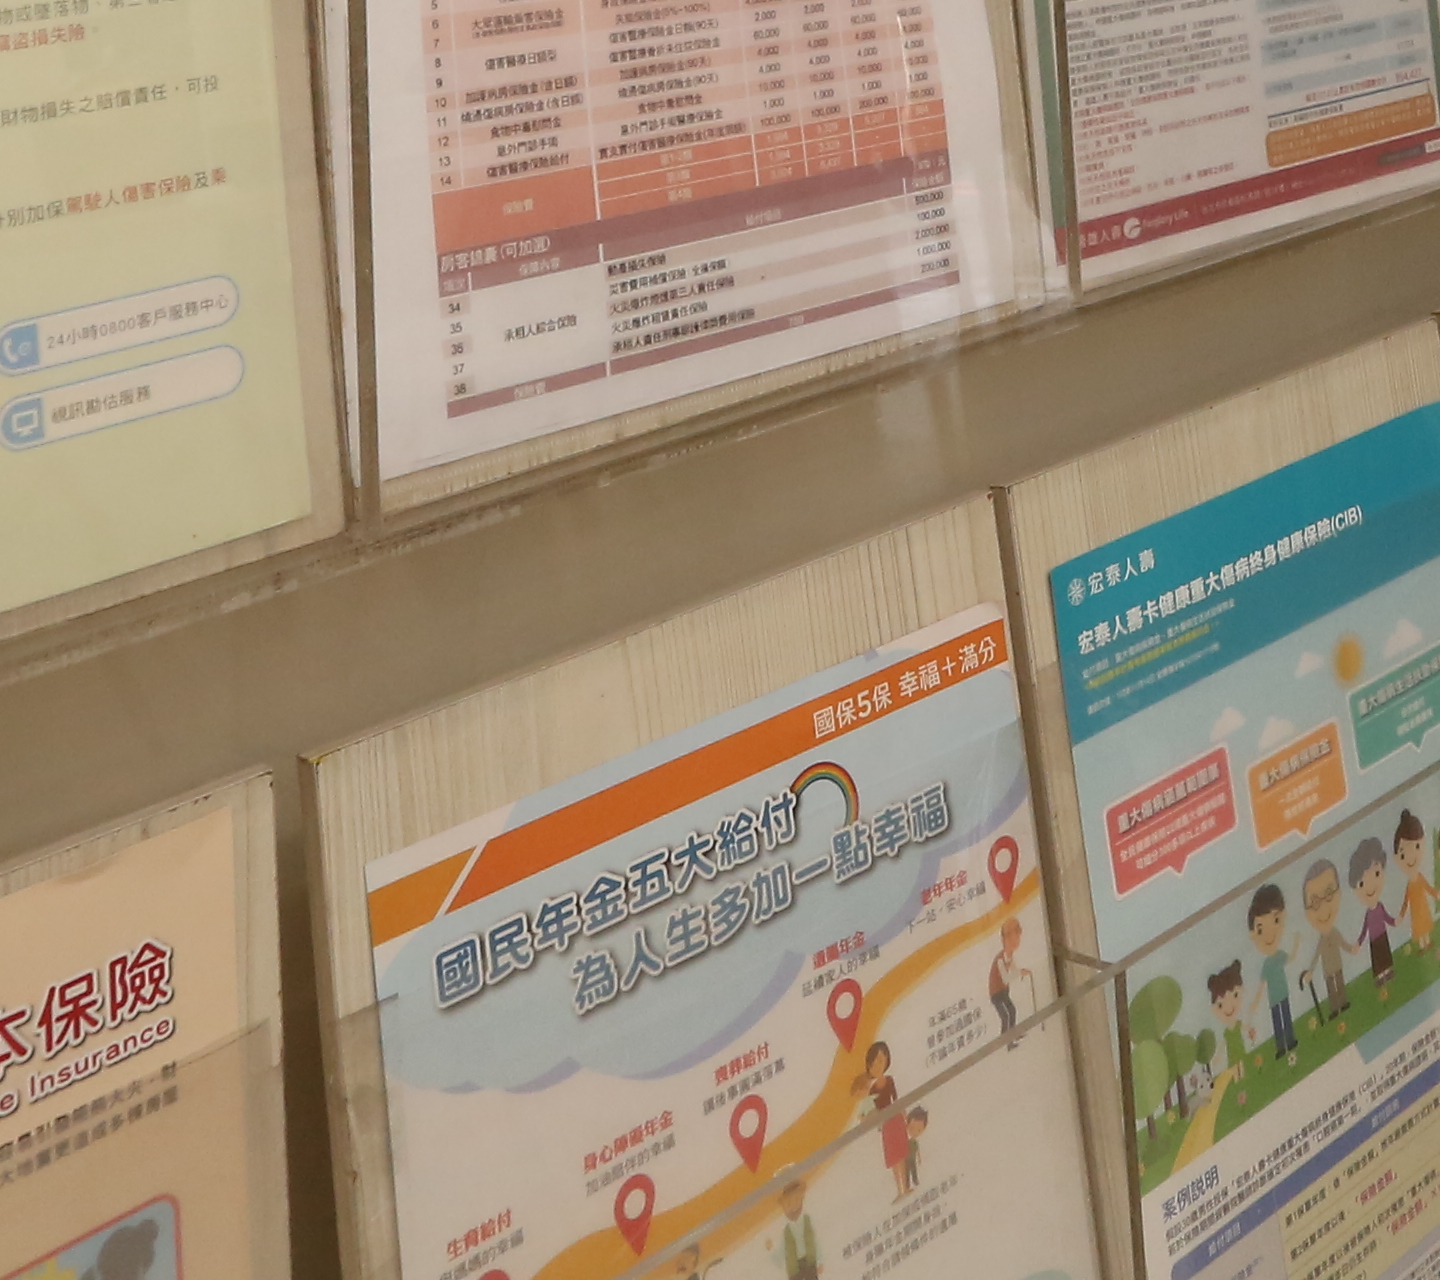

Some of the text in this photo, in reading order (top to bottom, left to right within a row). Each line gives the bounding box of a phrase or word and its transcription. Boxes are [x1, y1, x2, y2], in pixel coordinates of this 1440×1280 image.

[46, 292, 231, 350] 24小時0800客戶服務中心
[447, 301, 462, 315] 34
[451, 362, 466, 376] 37
[1077, 505, 1365, 657] 宏泰人壽卡健康重大傷病終身健康保險(CIB)
[1086, 547, 1157, 597] 宏泰人壽
[812, 636, 999, 741] 國保5保 幸福＋滿分
[435, 790, 798, 1010] 國民年金五大給付
[572, 782, 951, 1015] 為人生多加一點幸福
[920, 869, 969, 907] 老年年金
[801, 943, 882, 999] 延續家人的幸福
[812, 930, 867, 971] 遺屬年金
[925, 1023, 989, 1070] (不論年資多少)
[926, 1006, 982, 1051] 曾參加過國保
[28, 1017, 176, 1105] Insurance
[703, 1057, 787, 1118] 讓後事圓滿落幕
[713, 1040, 772, 1088] 喪葬給付
[582, 1108, 676, 1175] 身心障礙年金
[585, 1133, 678, 1199] 加油陪伴的幸福
[1161, 1164, 1221, 1221] 案例說明
[445, 1208, 515, 1261] 生育給付
